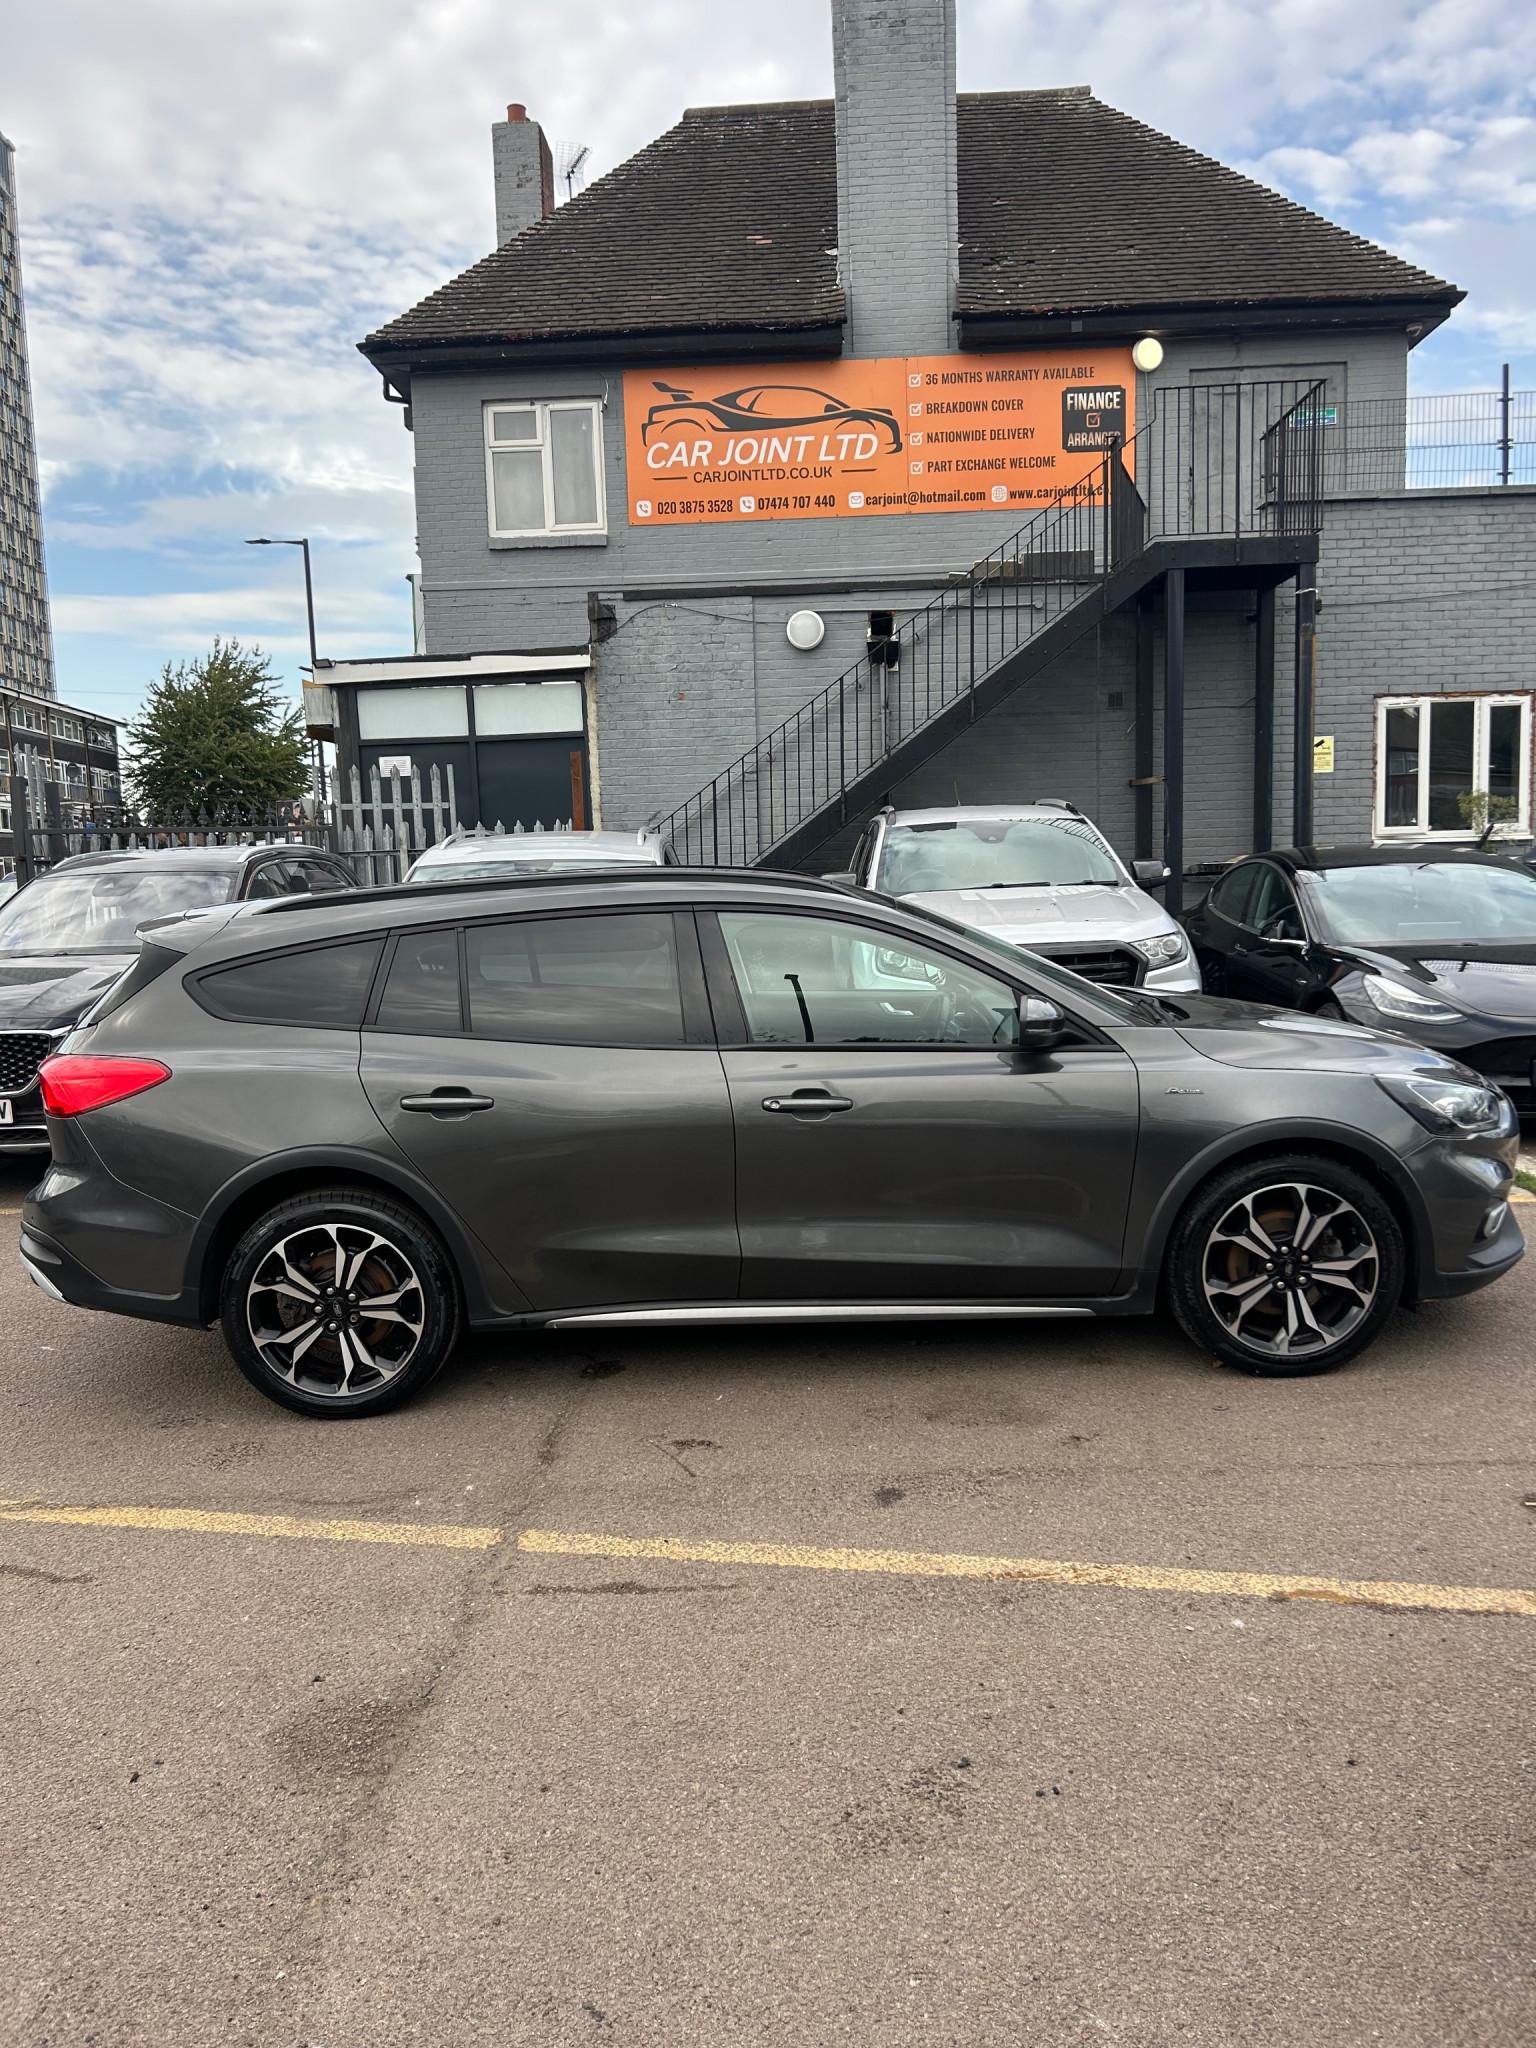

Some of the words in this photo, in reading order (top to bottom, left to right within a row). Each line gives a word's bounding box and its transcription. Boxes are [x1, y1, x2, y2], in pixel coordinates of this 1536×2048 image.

[925, 373, 938, 385] 36
[941, 372, 983, 384] MONTHS
[986, 369, 1040, 382] WARRANTY
[1042, 367, 1095, 380] AVAILABLE
[926, 400, 988, 414] BREAKDOWN
[991, 399, 1024, 412] COVER
[1066, 391, 1121, 411] FINANCE
[926, 430, 987, 443] NATIONWIDE
[989, 428, 1035, 441] DELIVERY
[646, 440, 711, 469] CAR
[717, 435, 815, 467] JOINT
[818, 433, 878, 461] LTD
[927, 460, 952, 473] PART
[955, 458, 1007, 471] EXCHANGE
[1009, 456, 1056, 469] WELCOME
[693, 466, 833, 483] CARJOINTLTD.CO.UK
[657, 501, 677, 514] 020
[679, 500, 705, 514] 3875
[707, 499, 733, 513] 3528
[757, 497, 789, 511] 07474
[792, 496, 812, 509] 707
[815, 494, 835, 508] 440
[865, 490, 986, 507] carjoint@hotmail.com
